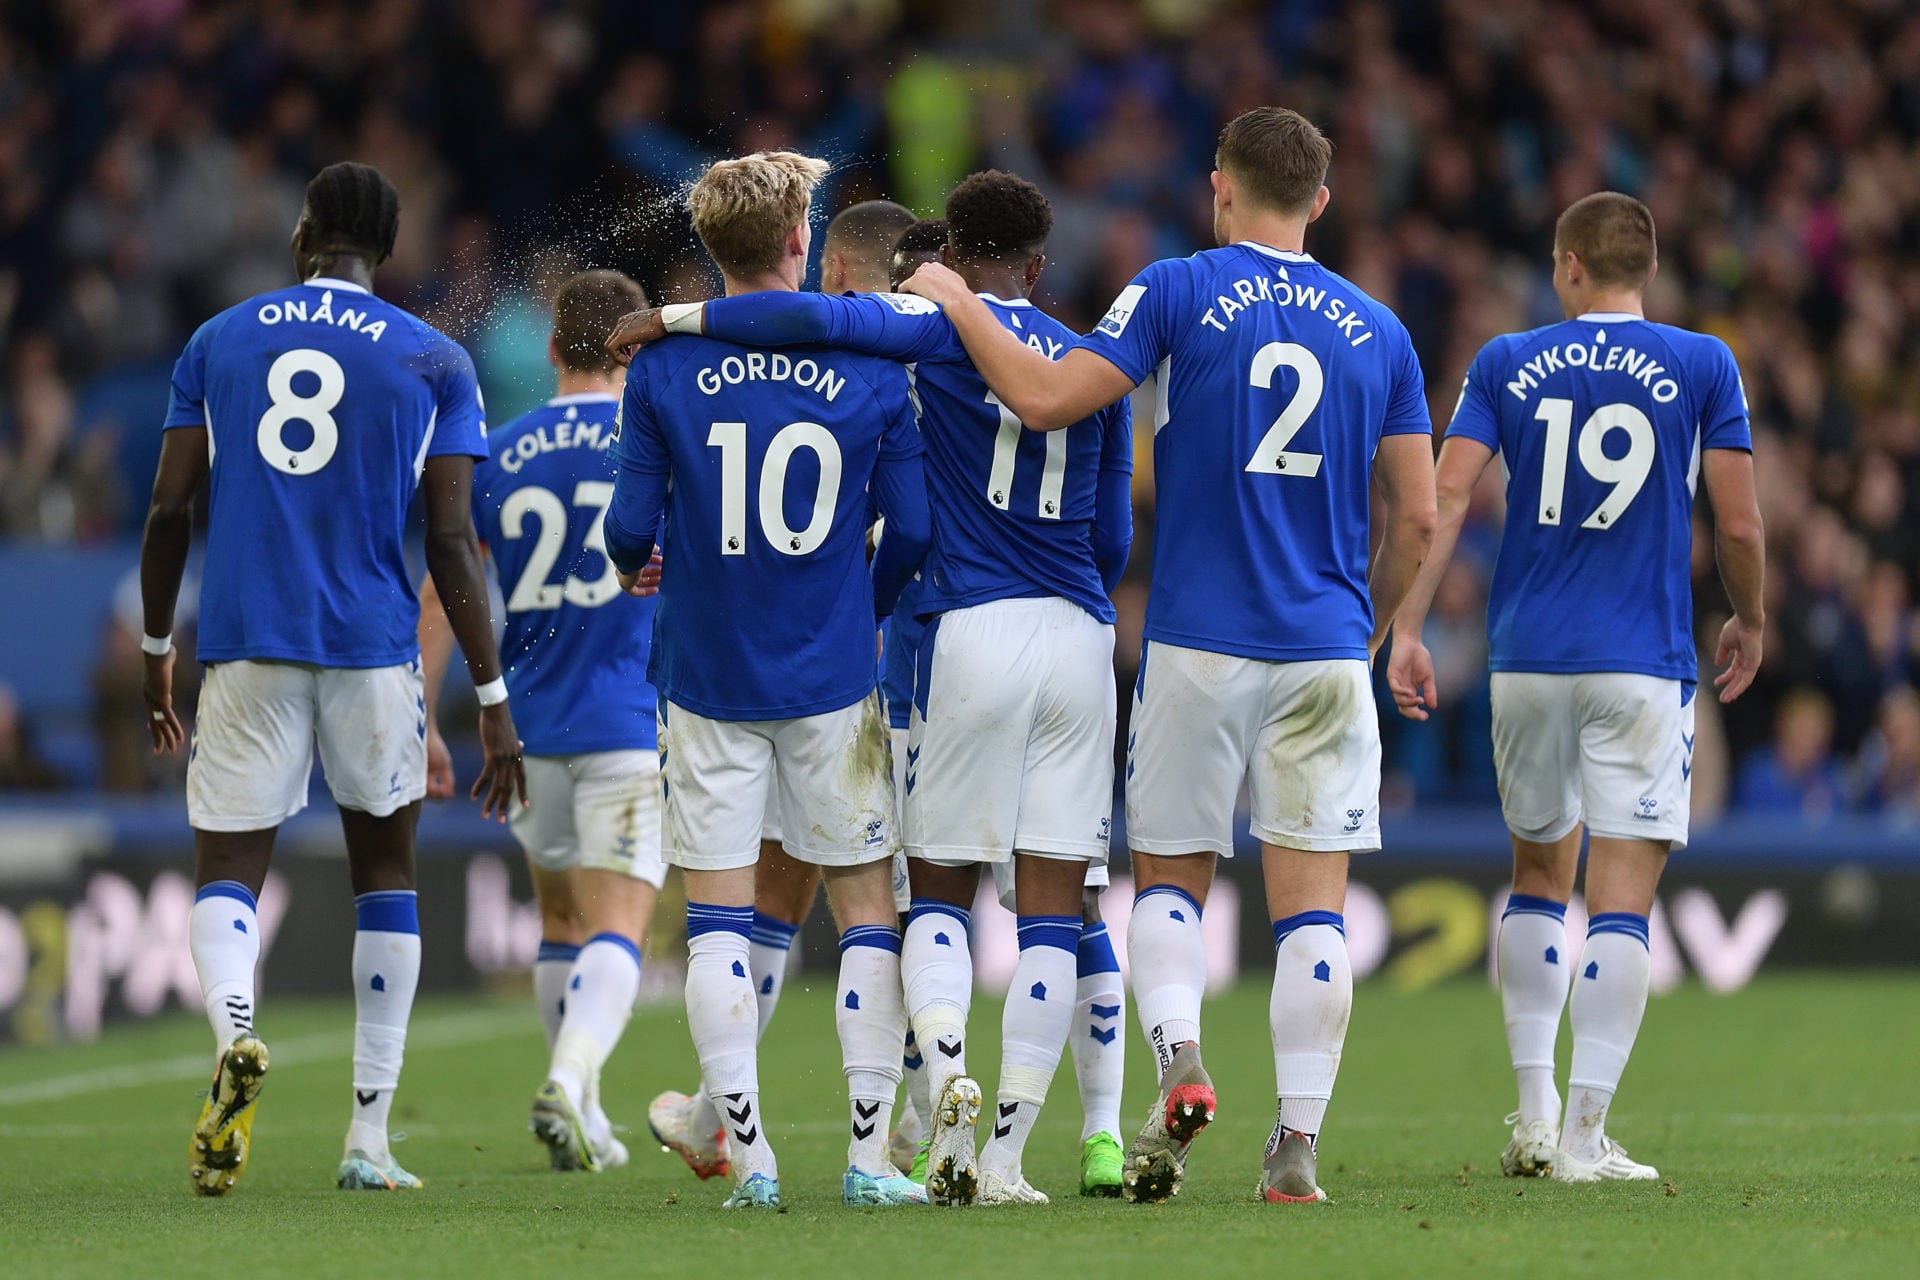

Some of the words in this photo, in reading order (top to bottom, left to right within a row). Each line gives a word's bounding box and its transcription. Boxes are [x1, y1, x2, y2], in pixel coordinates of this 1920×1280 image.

[258, 301, 388, 343] ONANA
[1108, 306, 1130, 321] XT
[1200, 276, 1373, 347] TARKOWSKI
[257, 348, 346, 475] 8
[696, 352, 846, 402] GORDON
[1244, 341, 1324, 478] 2
[1506, 342, 1679, 402] MYKOLENKO
[706, 421, 843, 556] 10
[985, 388, 1068, 520] 11
[1535, 397, 1656, 530] 19
[501, 481, 620, 612] 23
[1155, 1036, 1170, 1076] TAPEDE
